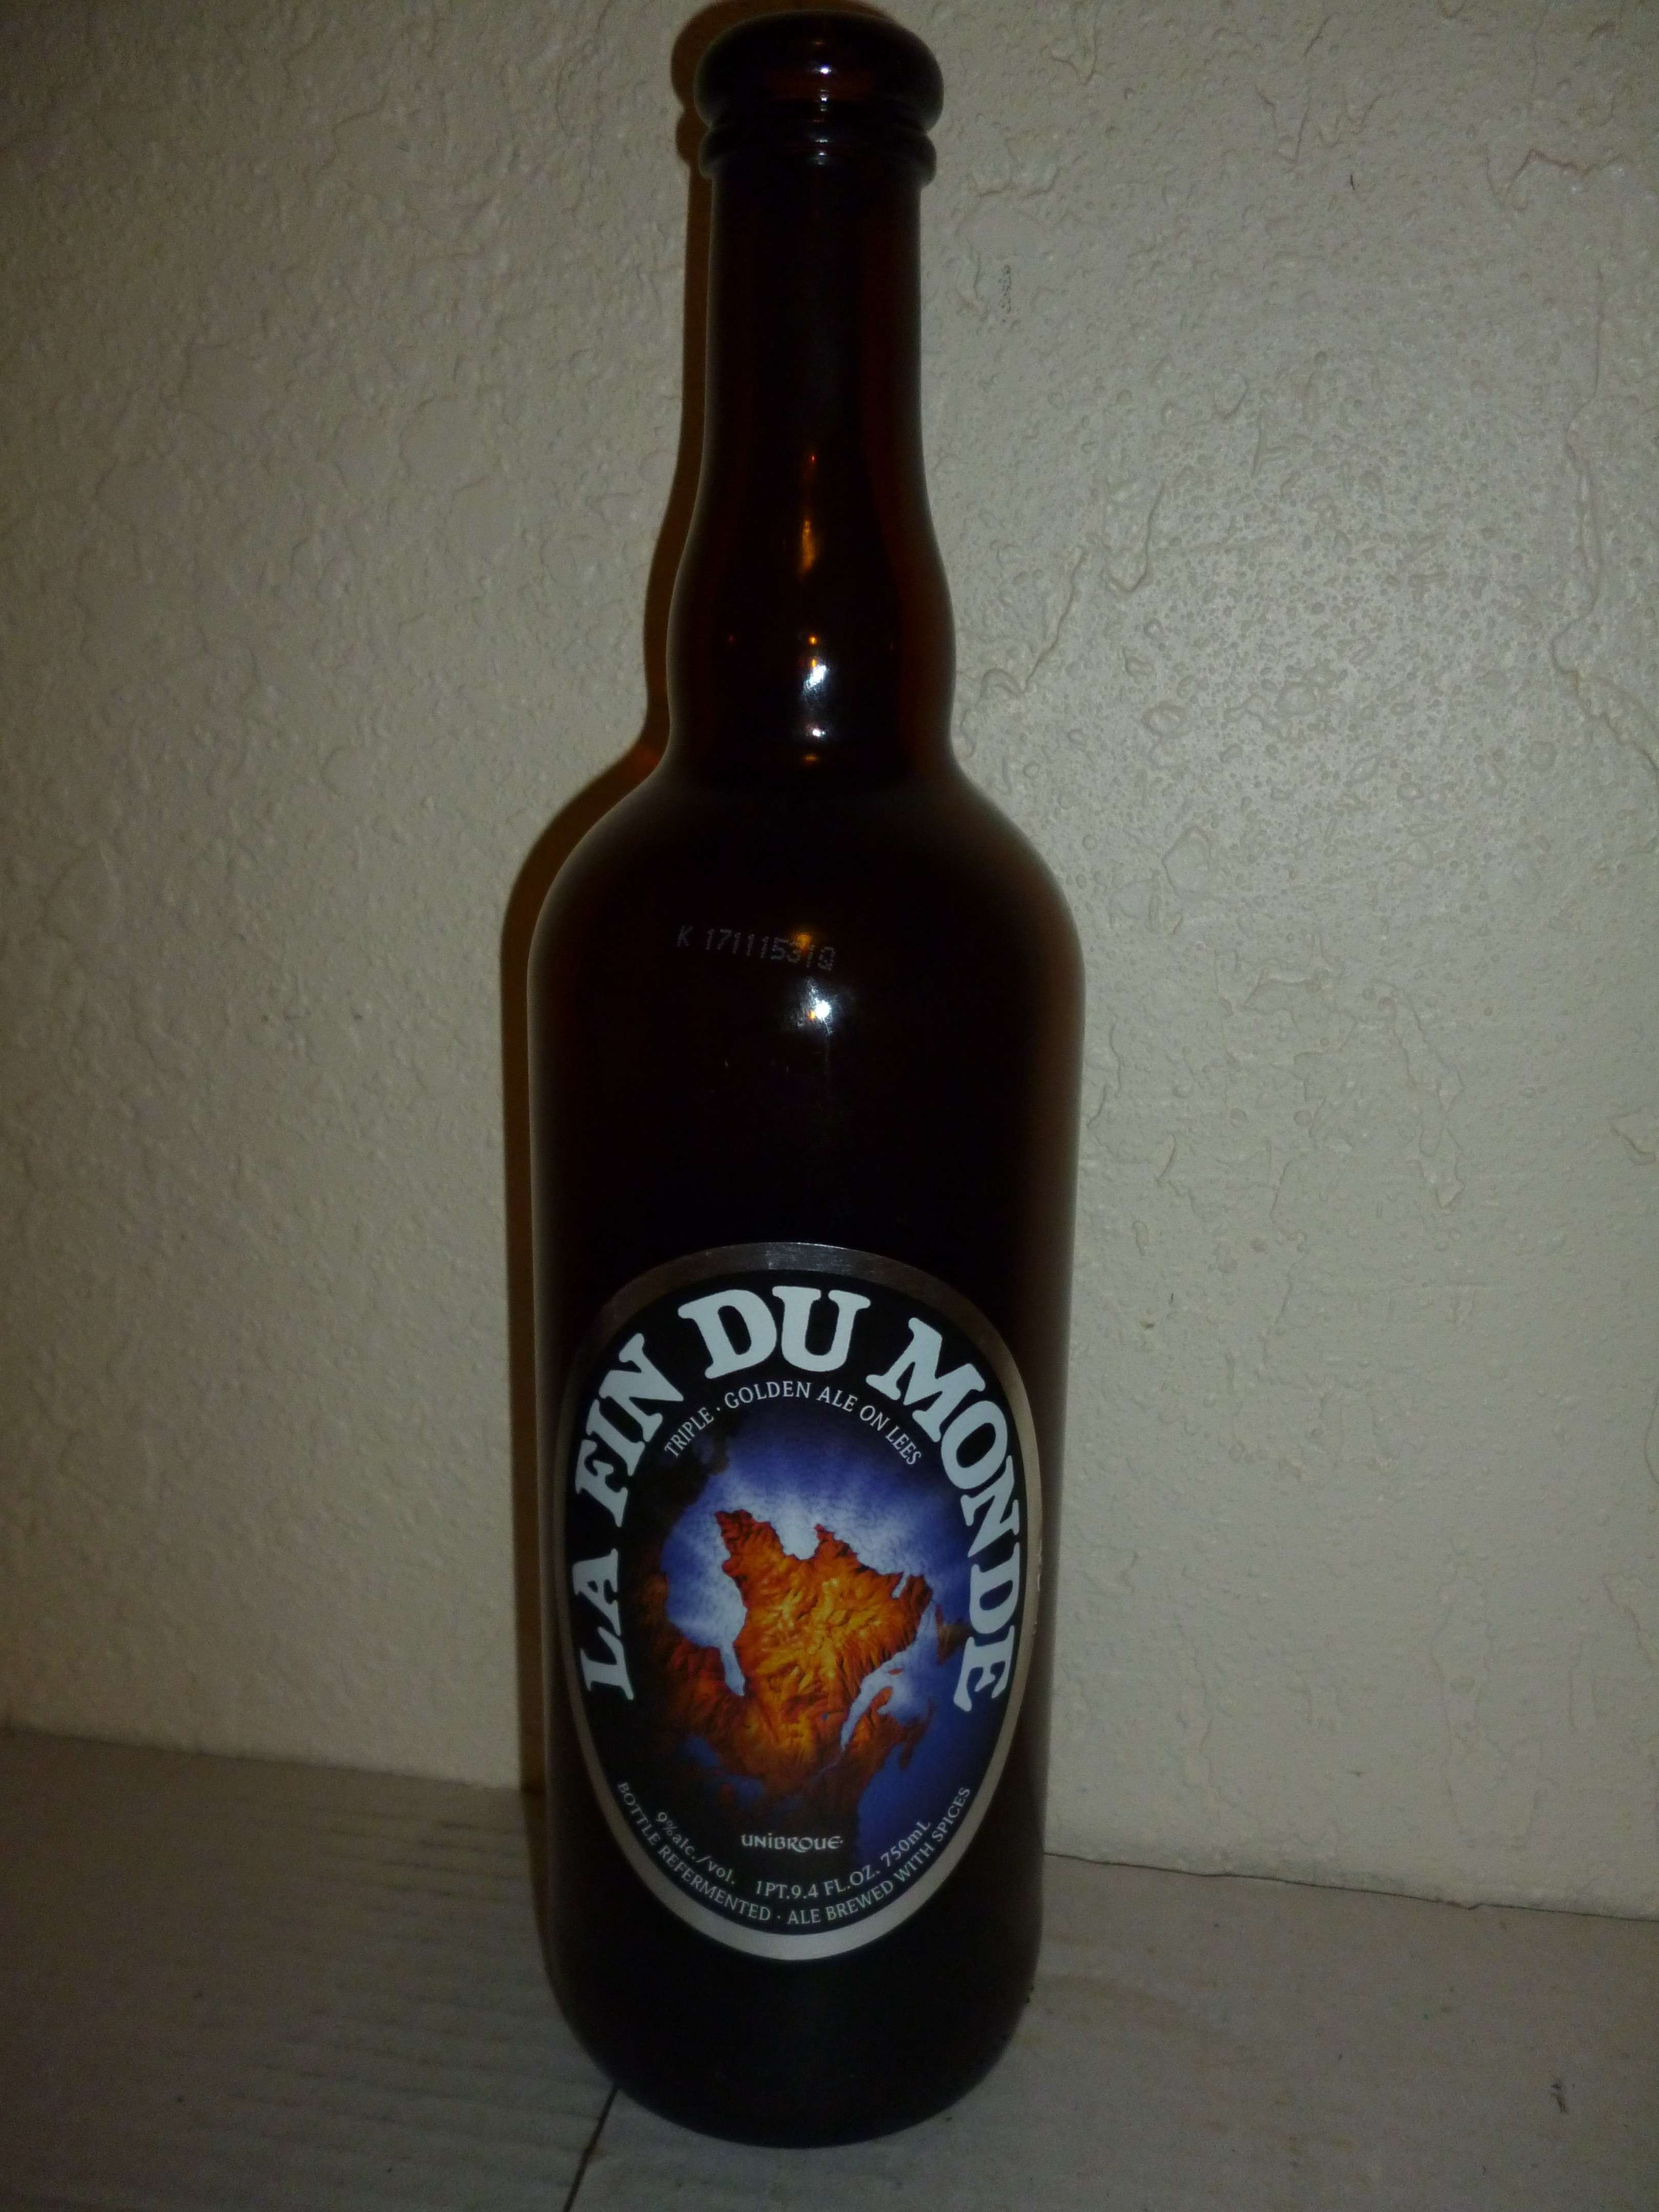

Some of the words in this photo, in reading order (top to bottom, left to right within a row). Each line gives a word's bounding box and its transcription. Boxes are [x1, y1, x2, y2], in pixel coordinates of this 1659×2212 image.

[677, 1285, 871, 1380] DU
[575, 1333, 684, 1527] FIN
[665, 1406, 714, 1458] TRIPLE
[725, 1381, 811, 1409] GOLDEN
[817, 1387, 858, 1412] ALE
[860, 1405, 890, 1432] ON
[885, 1426, 922, 1465] LEES
[866, 1317, 1020, 1712] MONDE
[572, 1549, 634, 1700] LA
[618, 1782, 660, 1845] BOTTLE
[657, 1845, 771, 1921] REFERMENTED
[788, 1908, 820, 1925] ALE
[825, 1880, 894, 1921] BREWED
[893, 1842, 934, 1883] WITH
[932, 1787, 970, 1843] SPICES
[881, 1820, 931, 1867] 750mL
